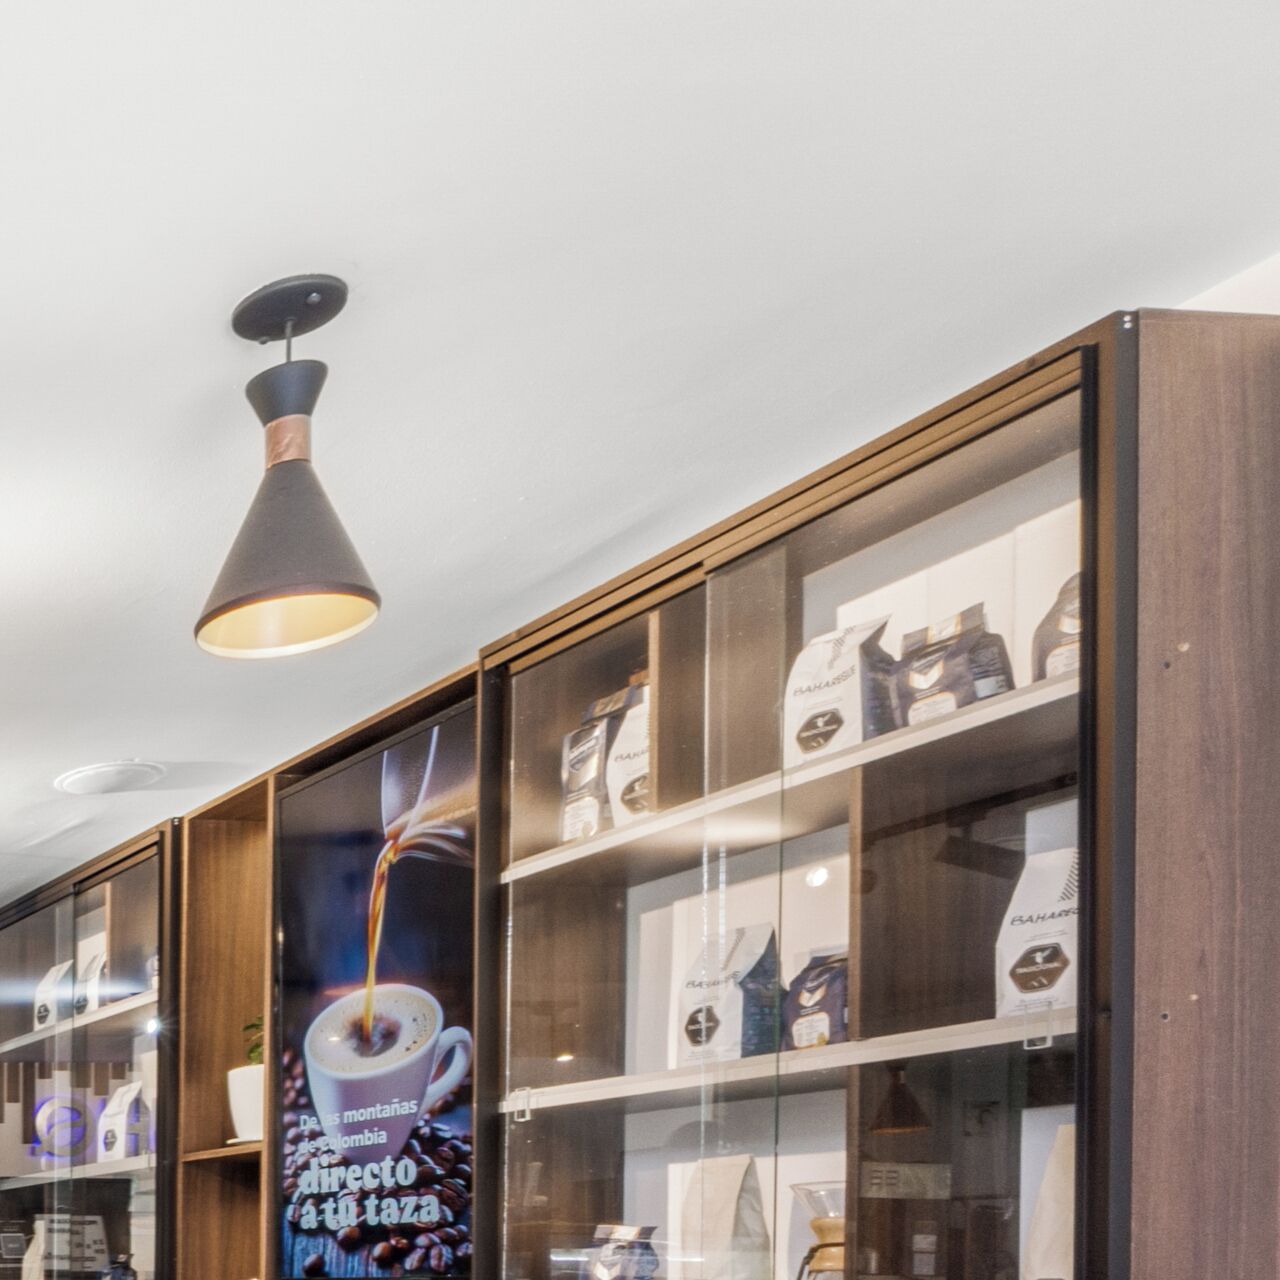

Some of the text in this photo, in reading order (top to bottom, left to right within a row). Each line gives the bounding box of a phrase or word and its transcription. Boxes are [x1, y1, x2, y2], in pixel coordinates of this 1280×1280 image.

[298, 1114, 318, 1131] De
[343, 1097, 419, 1124] montañas
[297, 1154, 418, 1195] directo
[299, 1193, 441, 1231] a tu taza
